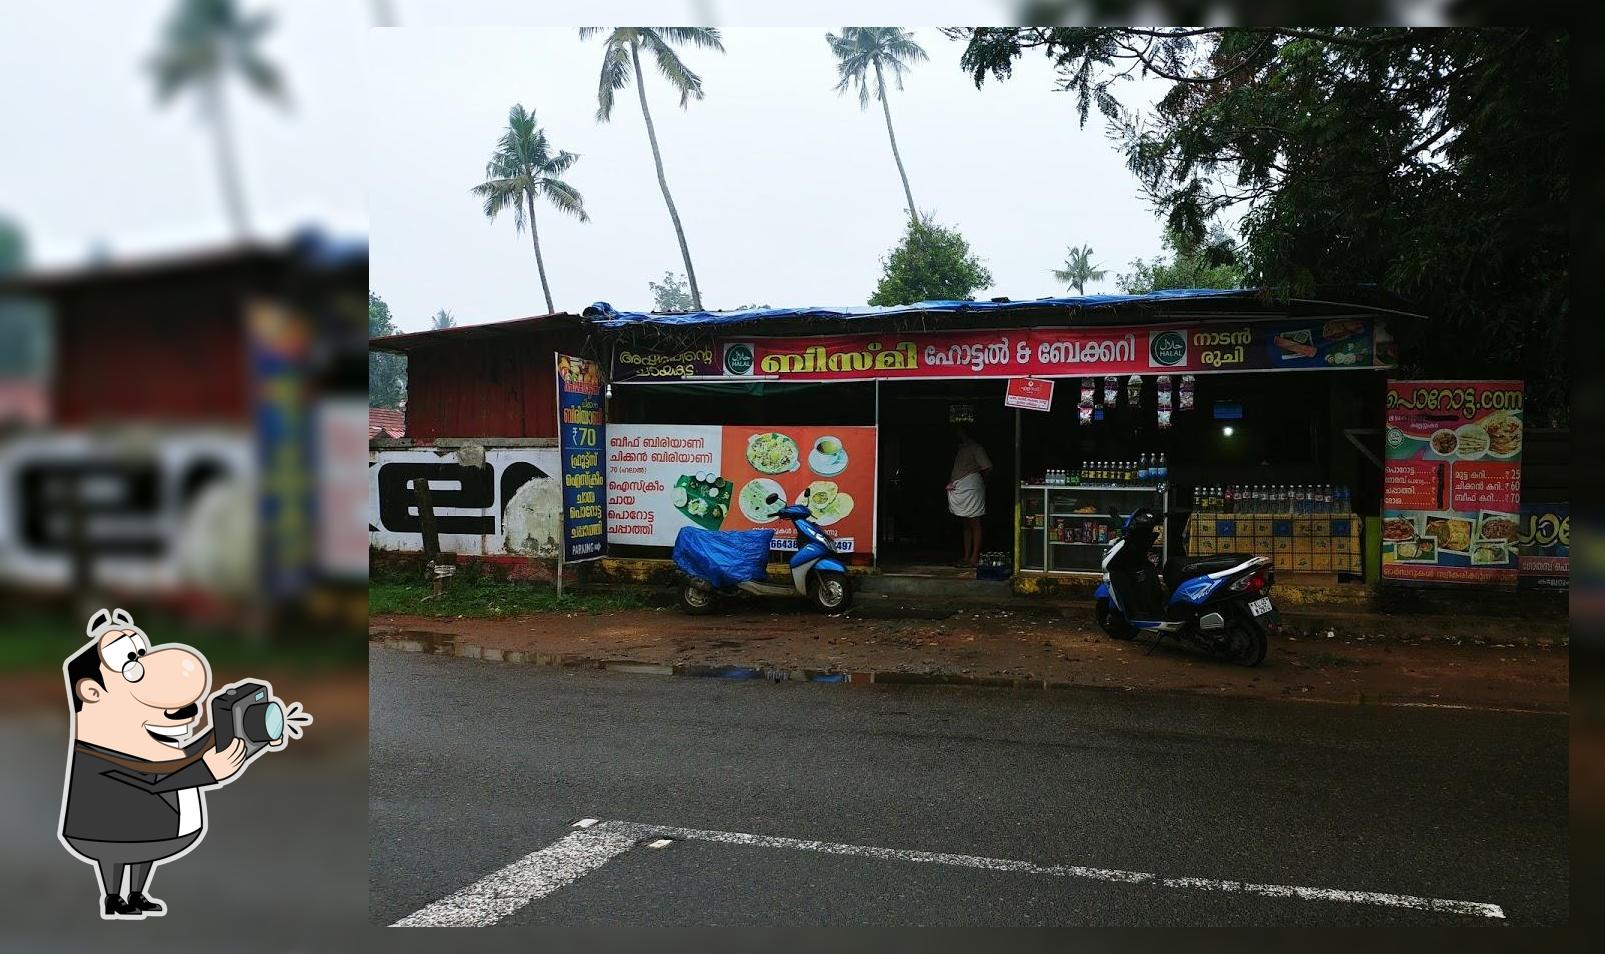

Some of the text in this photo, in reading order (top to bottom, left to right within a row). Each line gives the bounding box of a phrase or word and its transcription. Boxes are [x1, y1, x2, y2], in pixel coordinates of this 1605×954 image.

[1193, 328, 1252, 347] നാടൻ
[760, 334, 1135, 373] ബിസ്മി ഹോട്ടൽ & ബേക്കറി
[1159, 350, 1183, 358] HALAL
[1201, 346, 1244, 368] രുചി
[610, 436, 705, 449] ബീഫ് ബിരിയാണി
[609, 450, 713, 464] ചിക്കൻ ബിരിയാണി
[608, 480, 665, 493] ഐസ്ക്രീം
[608, 496, 636, 505] ചായ
[608, 510, 655, 523] പൊറോട്ട
[607, 524, 653, 535] ചപ്പാത്തി
[571, 542, 594, 556] PARKING
